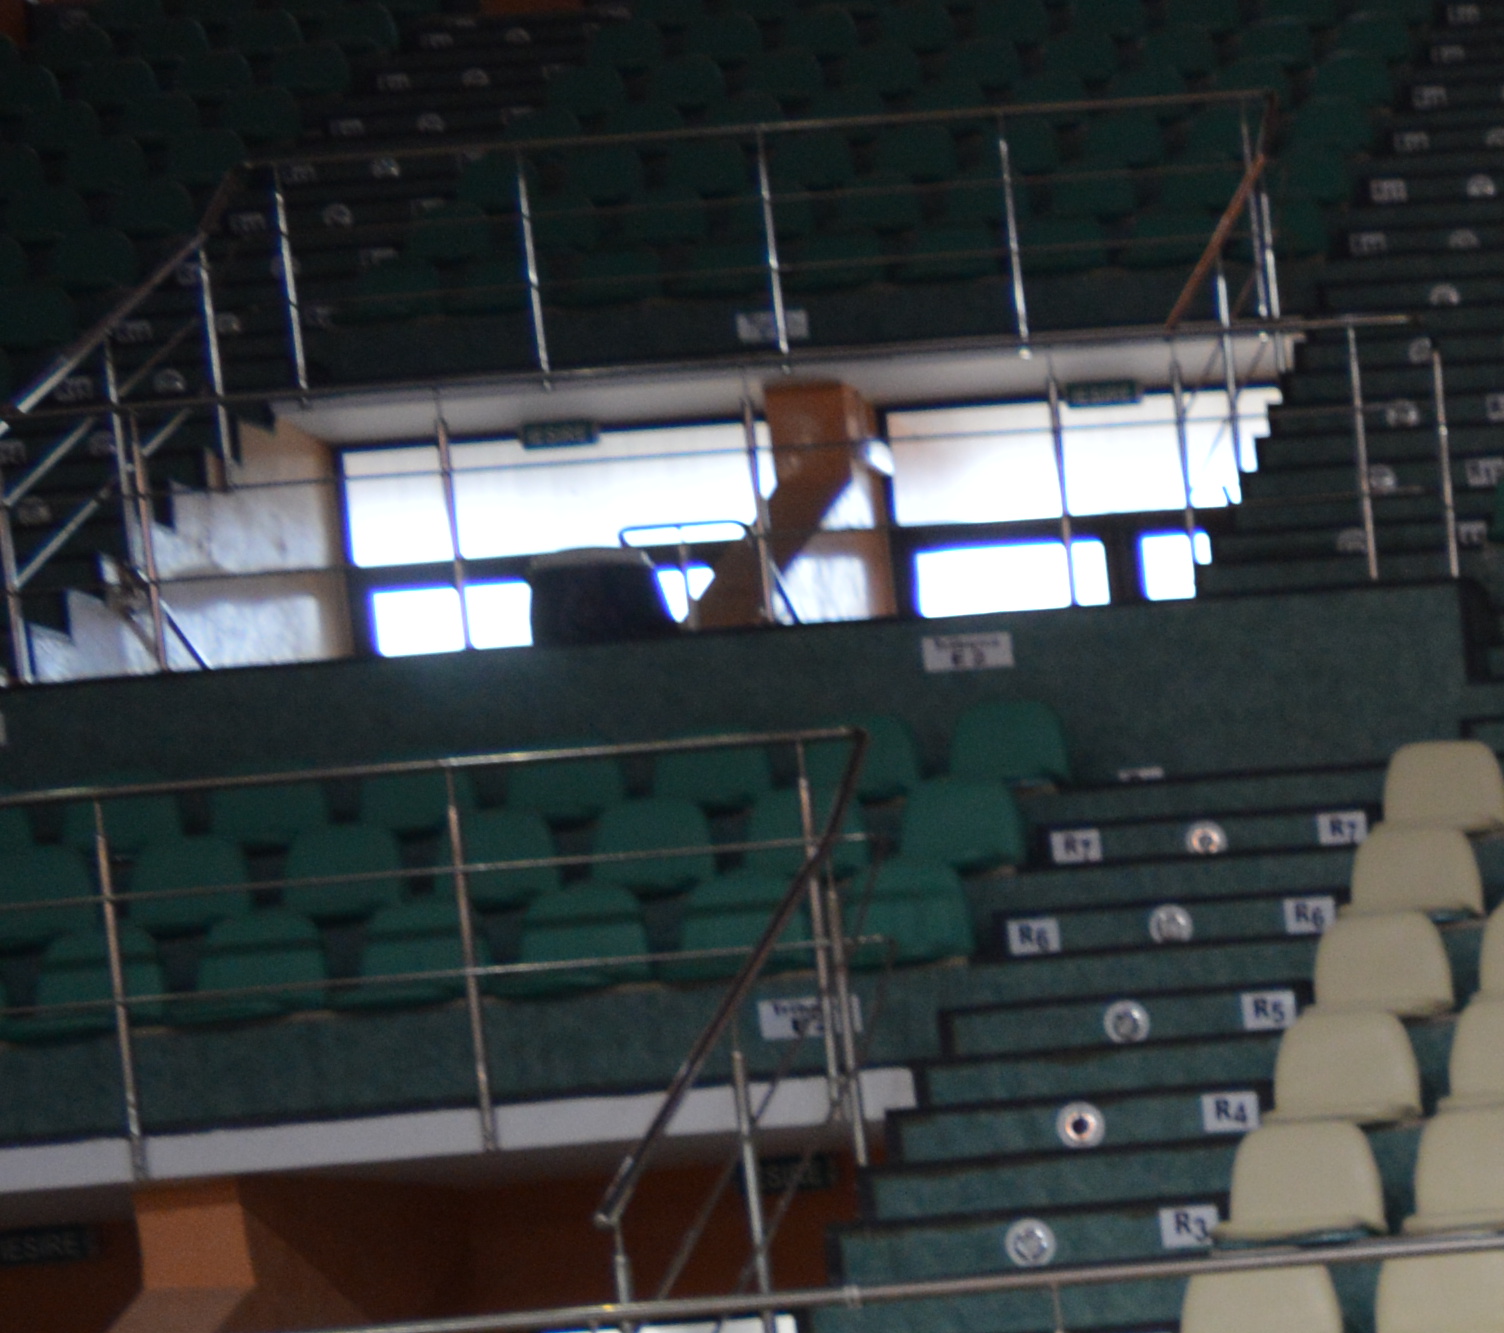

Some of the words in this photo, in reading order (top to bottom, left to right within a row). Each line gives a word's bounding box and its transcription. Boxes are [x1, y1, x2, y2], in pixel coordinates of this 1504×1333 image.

[1294, 902, 1324, 927] R6
[1018, 923, 1048, 949] R6
[1253, 997, 1284, 1022] R5
[1215, 1098, 1248, 1124] R4
[1174, 1211, 1210, 1239] R3
